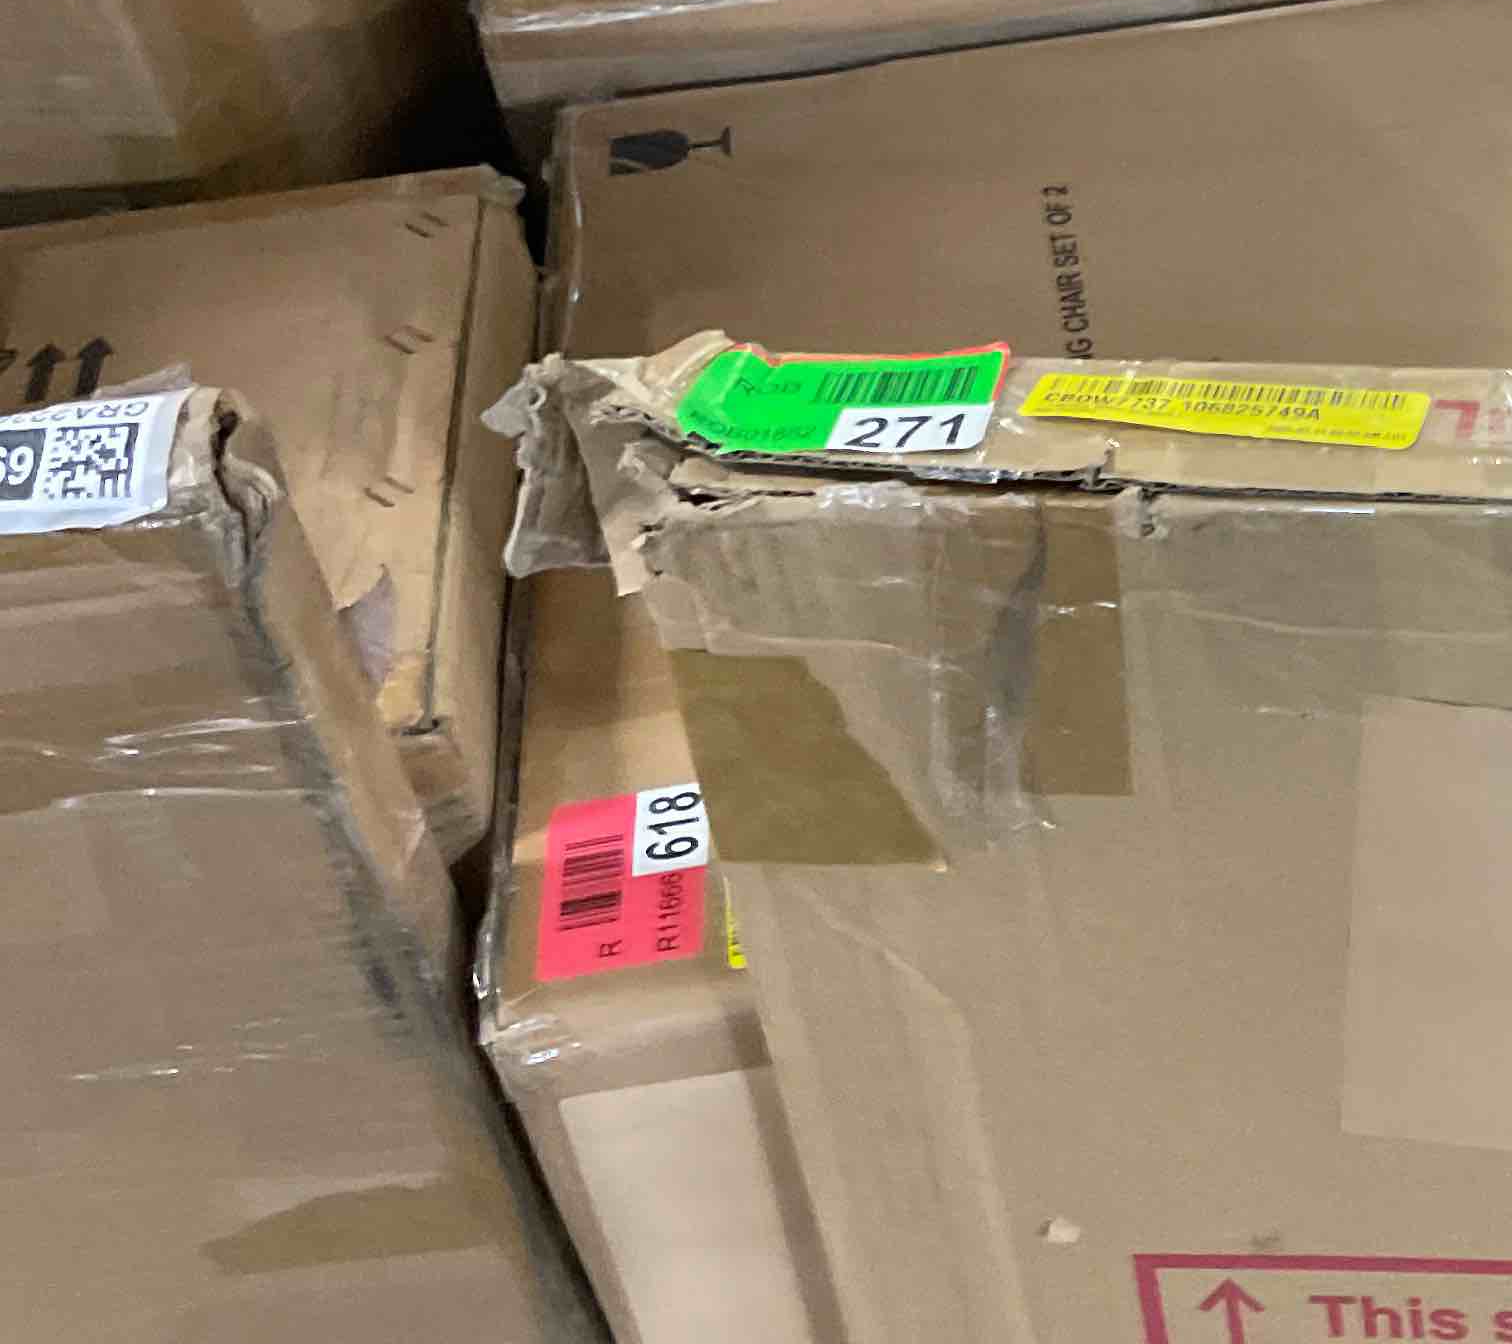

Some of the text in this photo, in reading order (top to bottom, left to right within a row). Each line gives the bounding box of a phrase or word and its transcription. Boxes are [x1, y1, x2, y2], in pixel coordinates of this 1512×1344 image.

[1042, 185, 1069, 197] 2
[1045, 202, 1073, 226] OF
[1049, 234, 1079, 268] SET
[1056, 272, 1089, 332] CHAIR
[845, 413, 966, 449] 271
[645, 790, 702, 861] 618
[599, 938, 623, 958] R
[1308, 1292, 1466, 1342] This
